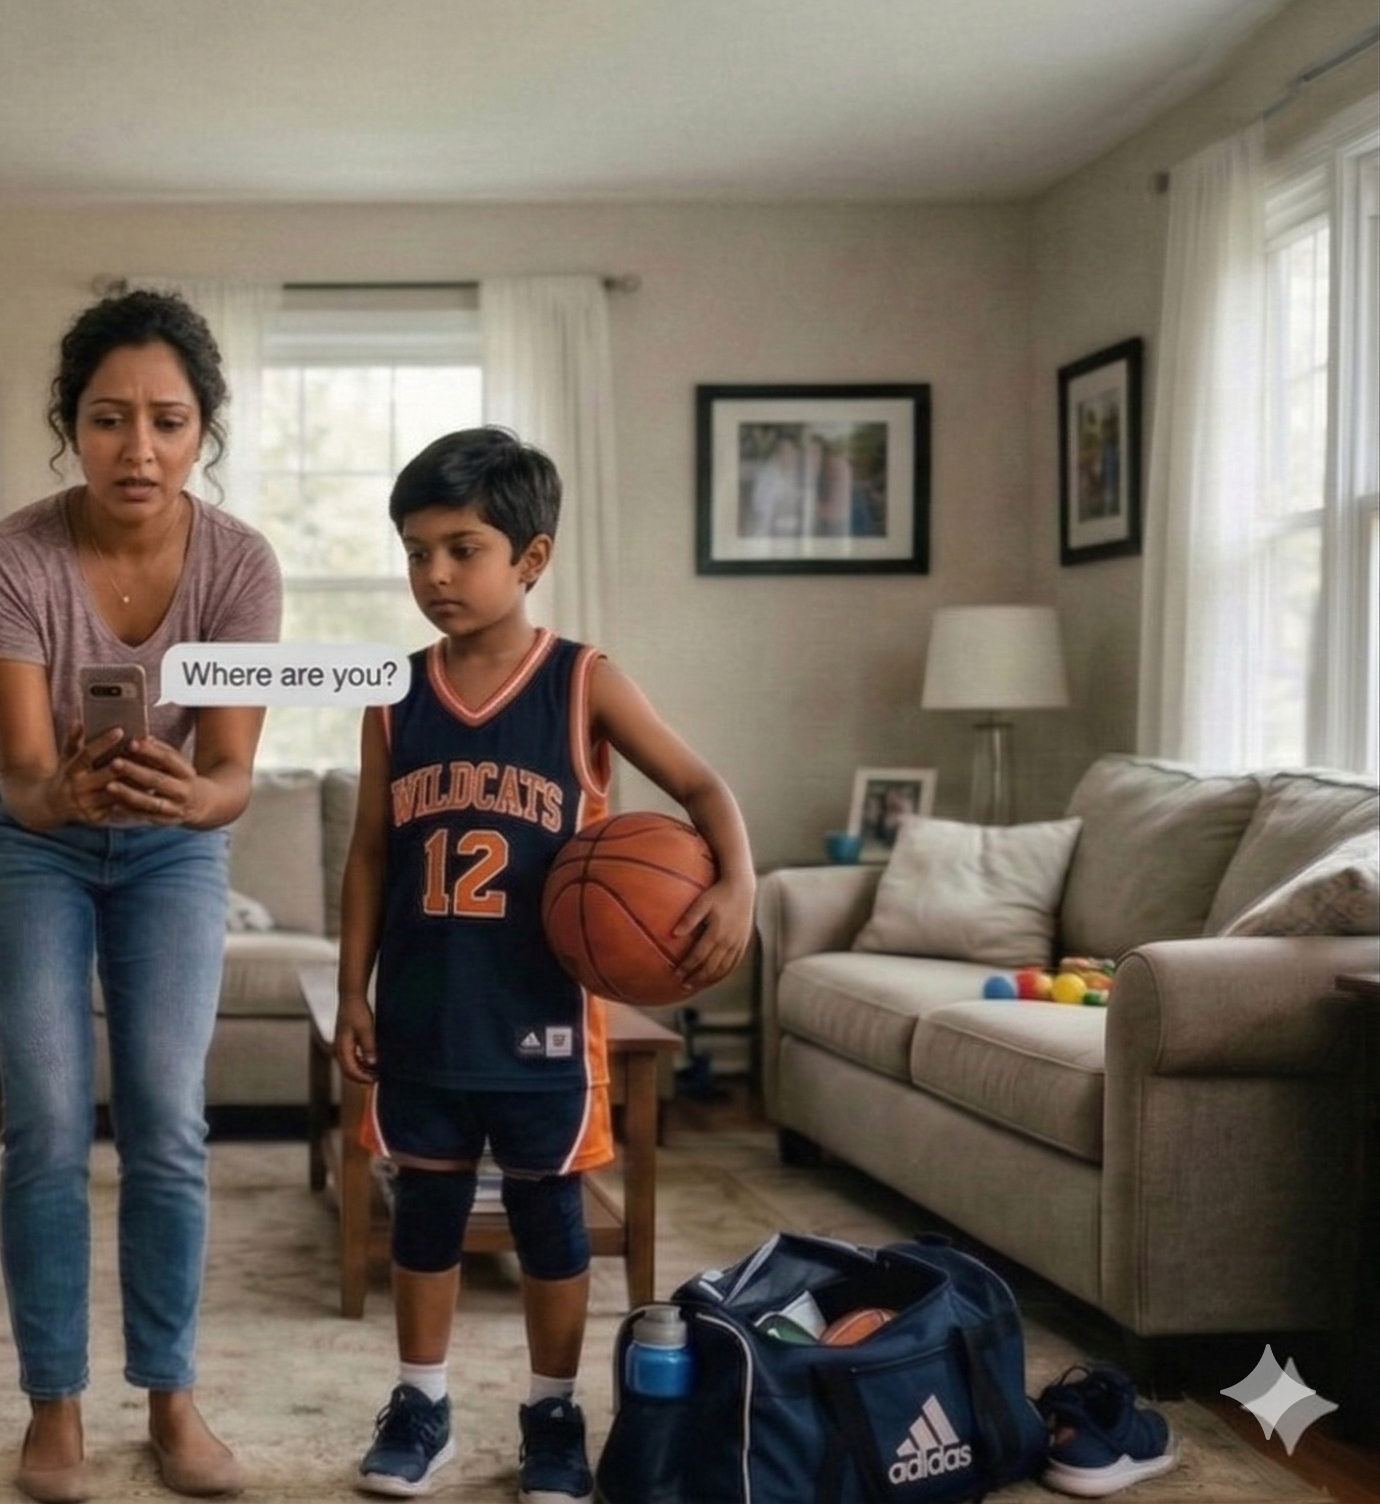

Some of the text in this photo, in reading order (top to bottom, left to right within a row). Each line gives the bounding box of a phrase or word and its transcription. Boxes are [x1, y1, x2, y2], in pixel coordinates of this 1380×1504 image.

[391, 761, 563, 833] WILDCATS
[423, 828, 509, 918] 12
[888, 1444, 972, 1485] adidas
